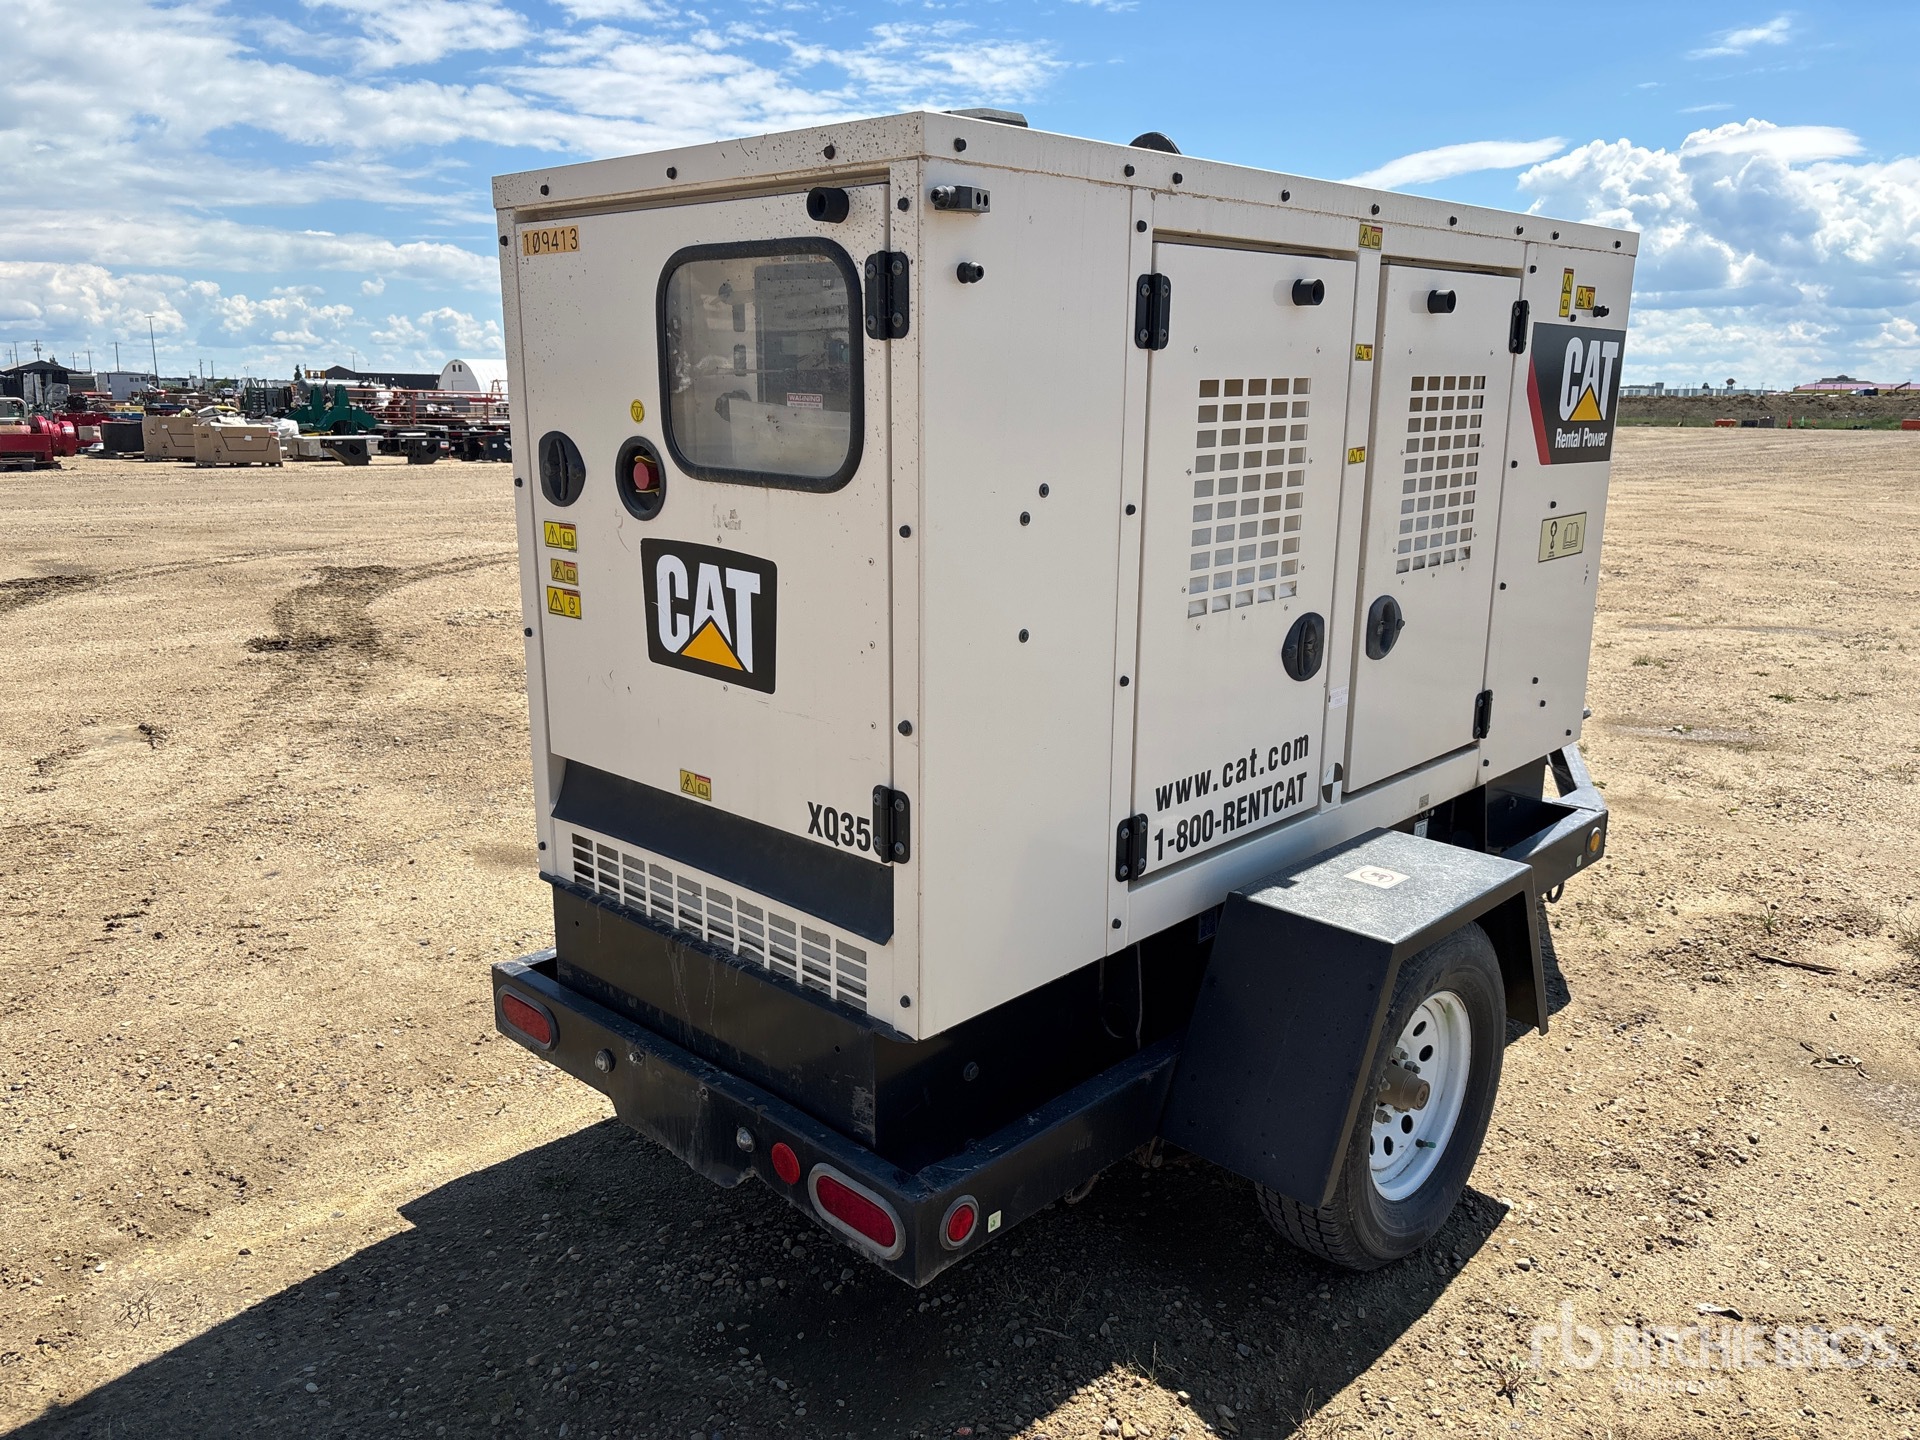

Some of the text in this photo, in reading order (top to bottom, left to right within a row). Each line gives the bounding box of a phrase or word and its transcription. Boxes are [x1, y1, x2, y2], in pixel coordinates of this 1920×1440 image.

[1560, 337, 1619, 421] CAT
[1555, 428, 1607, 448] Rental Power
[656, 554, 761, 673] CAT
[1155, 734, 1309, 812] www.cat.com
[807, 801, 871, 852] XQ35
[1154, 772, 1308, 861] 1-800-RENTCAT
